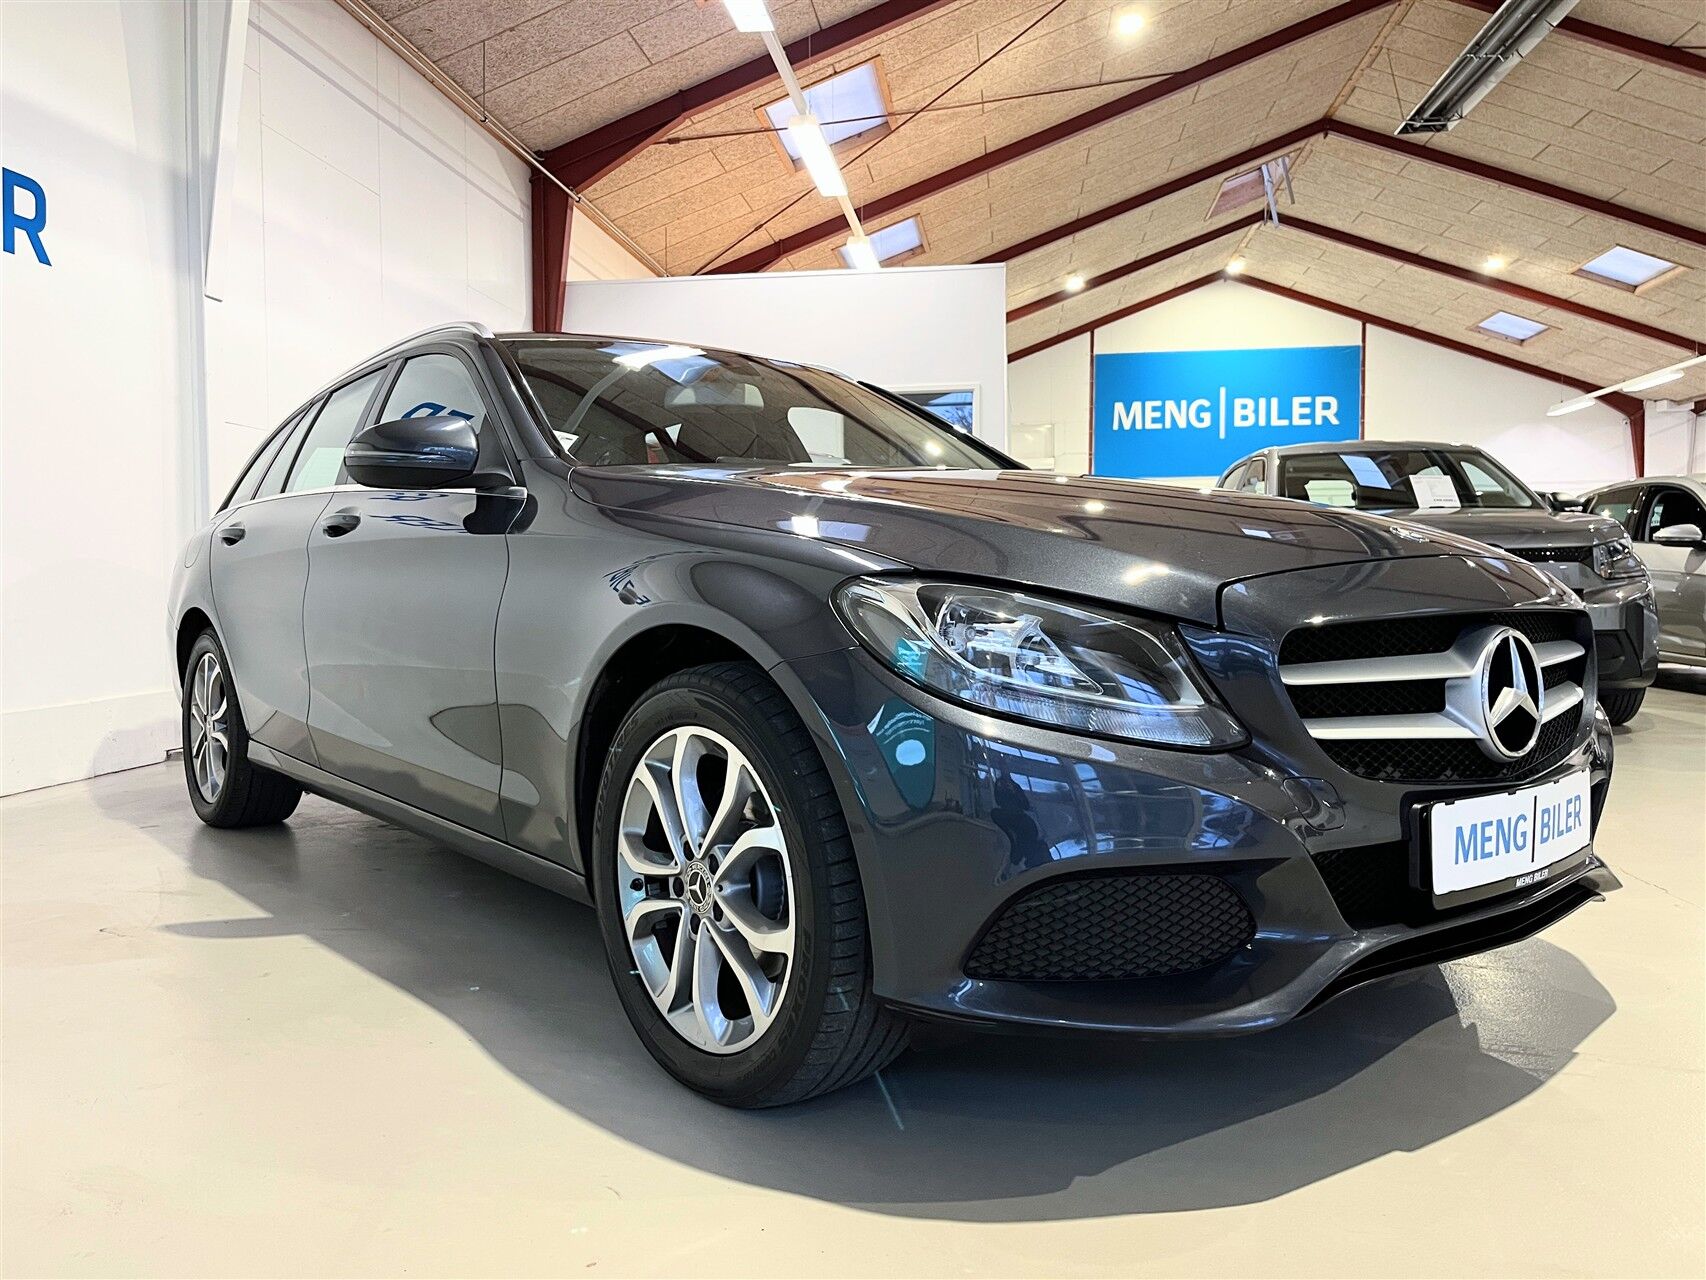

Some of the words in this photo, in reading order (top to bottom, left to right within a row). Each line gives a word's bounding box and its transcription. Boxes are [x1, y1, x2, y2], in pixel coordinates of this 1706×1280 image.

[1112, 398, 1212, 431] MENG
[1233, 395, 1340, 427] BILER
[1454, 814, 1528, 865] MENG
[1539, 794, 1582, 844] BILER
[1515, 874, 1534, 888] MENG
[1533, 868, 1549, 882] BILER
